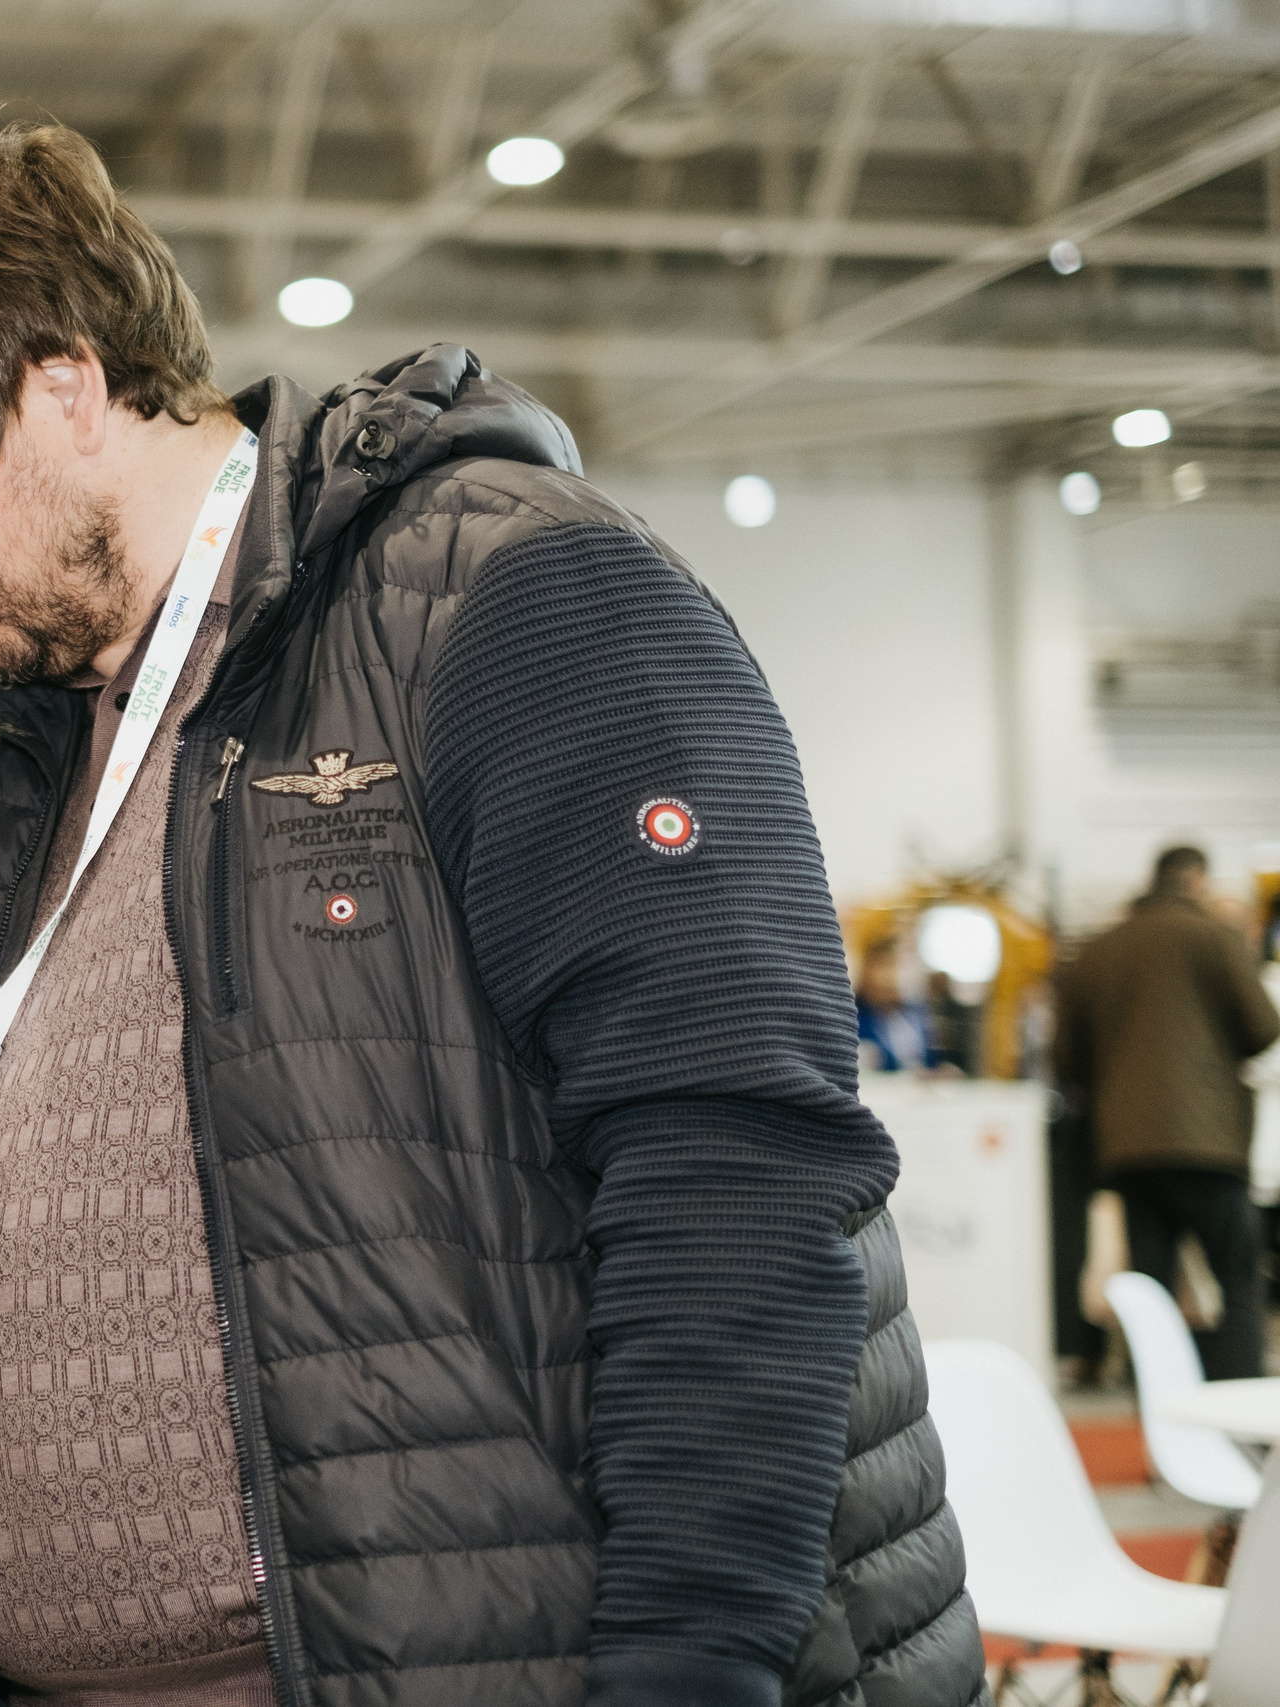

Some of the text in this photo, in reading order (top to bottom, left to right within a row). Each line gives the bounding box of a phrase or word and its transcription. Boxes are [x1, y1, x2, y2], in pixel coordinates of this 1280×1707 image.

[214, 458, 240, 494] TRADE
[169, 595, 189, 628] helios
[127, 664, 157, 721] TRADE
[263, 808, 410, 839] AERONAUTICA
[289, 825, 387, 849] MILITARE
[650, 836, 699, 856] MILITARE
[274, 853, 369, 875] OPERATIONS
